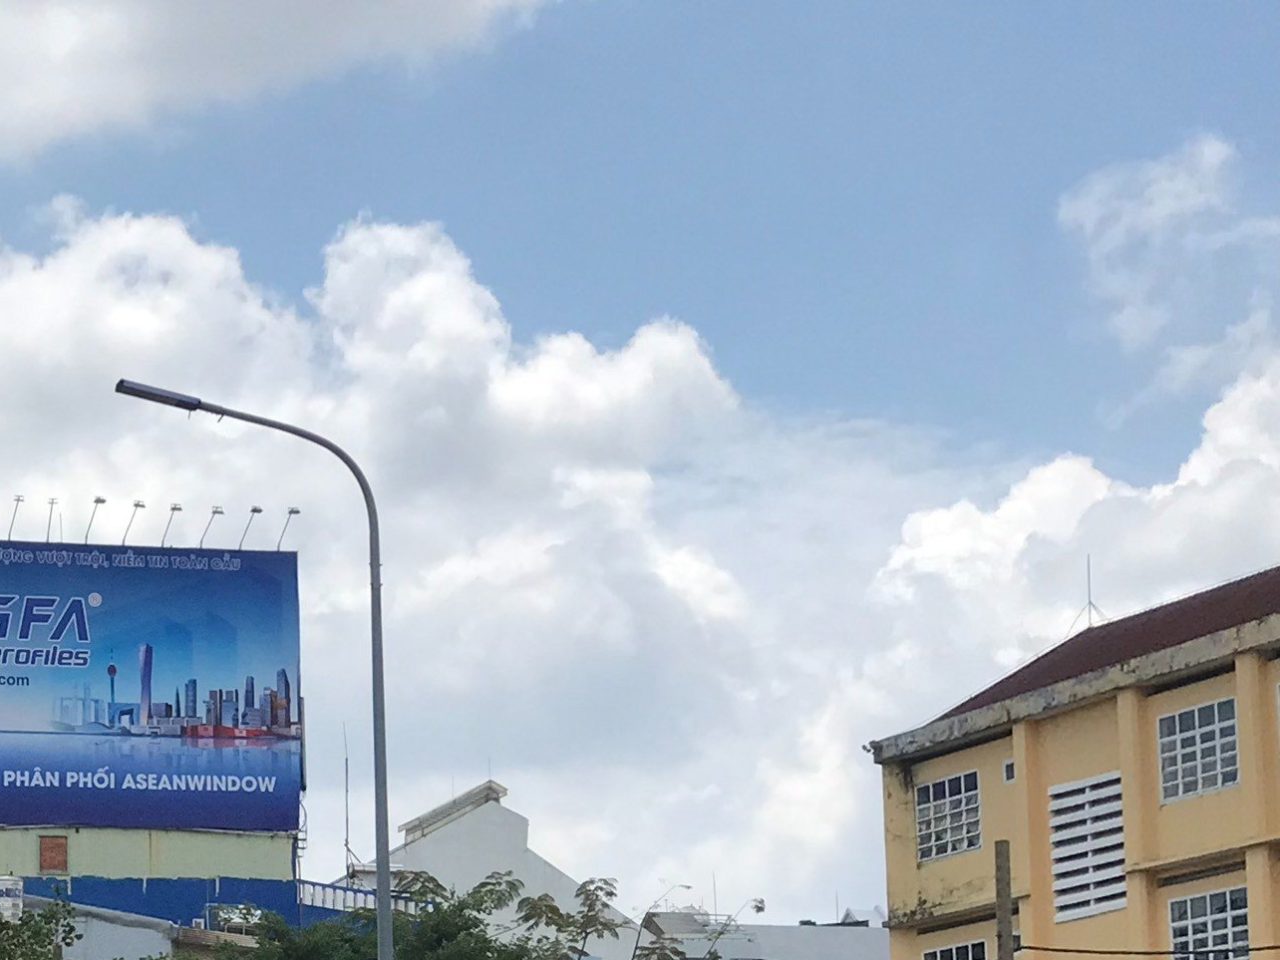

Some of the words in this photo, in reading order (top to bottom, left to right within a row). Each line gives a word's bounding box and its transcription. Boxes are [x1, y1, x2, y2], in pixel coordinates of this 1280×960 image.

[147, 555, 169, 569] TIN
[3, 766, 60, 789] PHÂN
[66, 765, 116, 790] PHỐI
[121, 772, 276, 793] ASEANWINDOW
